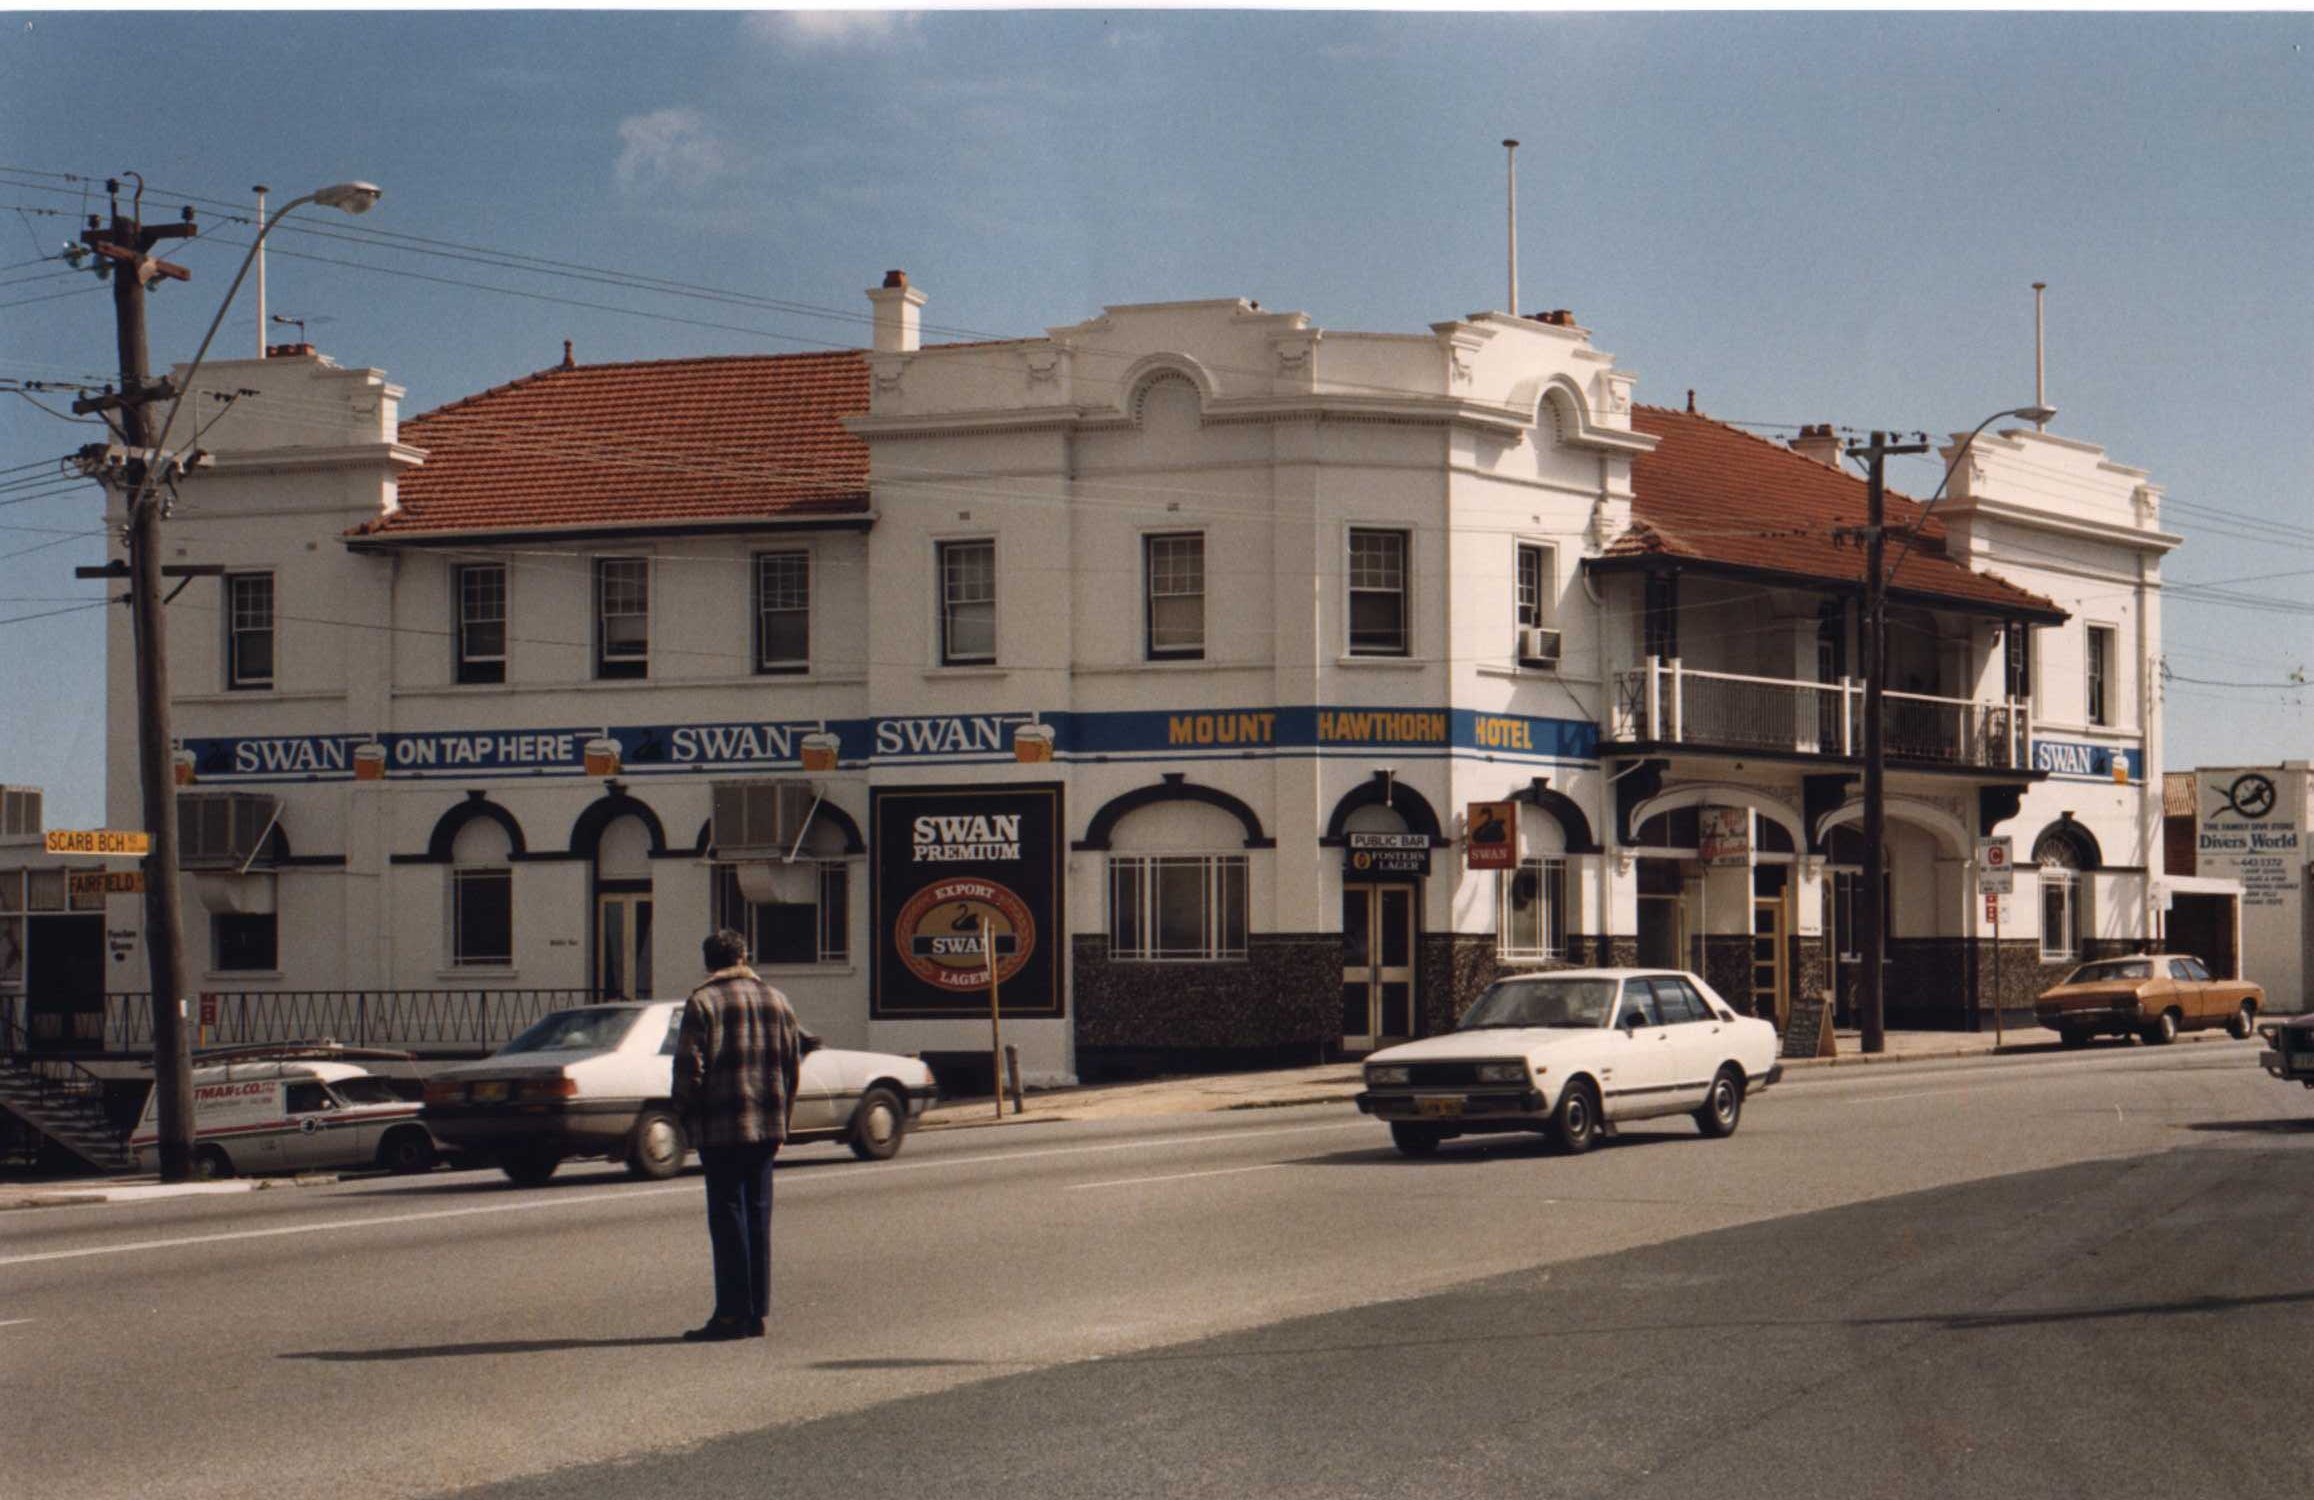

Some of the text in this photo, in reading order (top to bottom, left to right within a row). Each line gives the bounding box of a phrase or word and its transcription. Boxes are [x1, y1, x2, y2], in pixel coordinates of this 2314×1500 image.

[875, 718, 1003, 754] SWAN
[1168, 711, 1533, 750] MOUNT HAWTHORN HOTEL
[395, 735, 574, 765] ON TAP HERE
[671, 726, 792, 762] SWAN
[235, 738, 347, 772] SWAN
[2038, 743, 2092, 774] SWAN
[912, 814, 1021, 844] SWAN
[48, 832, 94, 852] SCARB
[98, 833, 125, 852] BCH
[1354, 835, 1426, 847] PUBLIC BAR
[2200, 833, 2298, 849] Divers World
[911, 843, 1021, 862] PREMIUM
[1471, 849, 1509, 860] SWAN
[1378, 860, 1419, 870] LAGER
[70, 873, 135, 893] FAIRFIELD
[935, 883, 996, 900] EXPORT
[939, 970, 993, 986] LAGER
